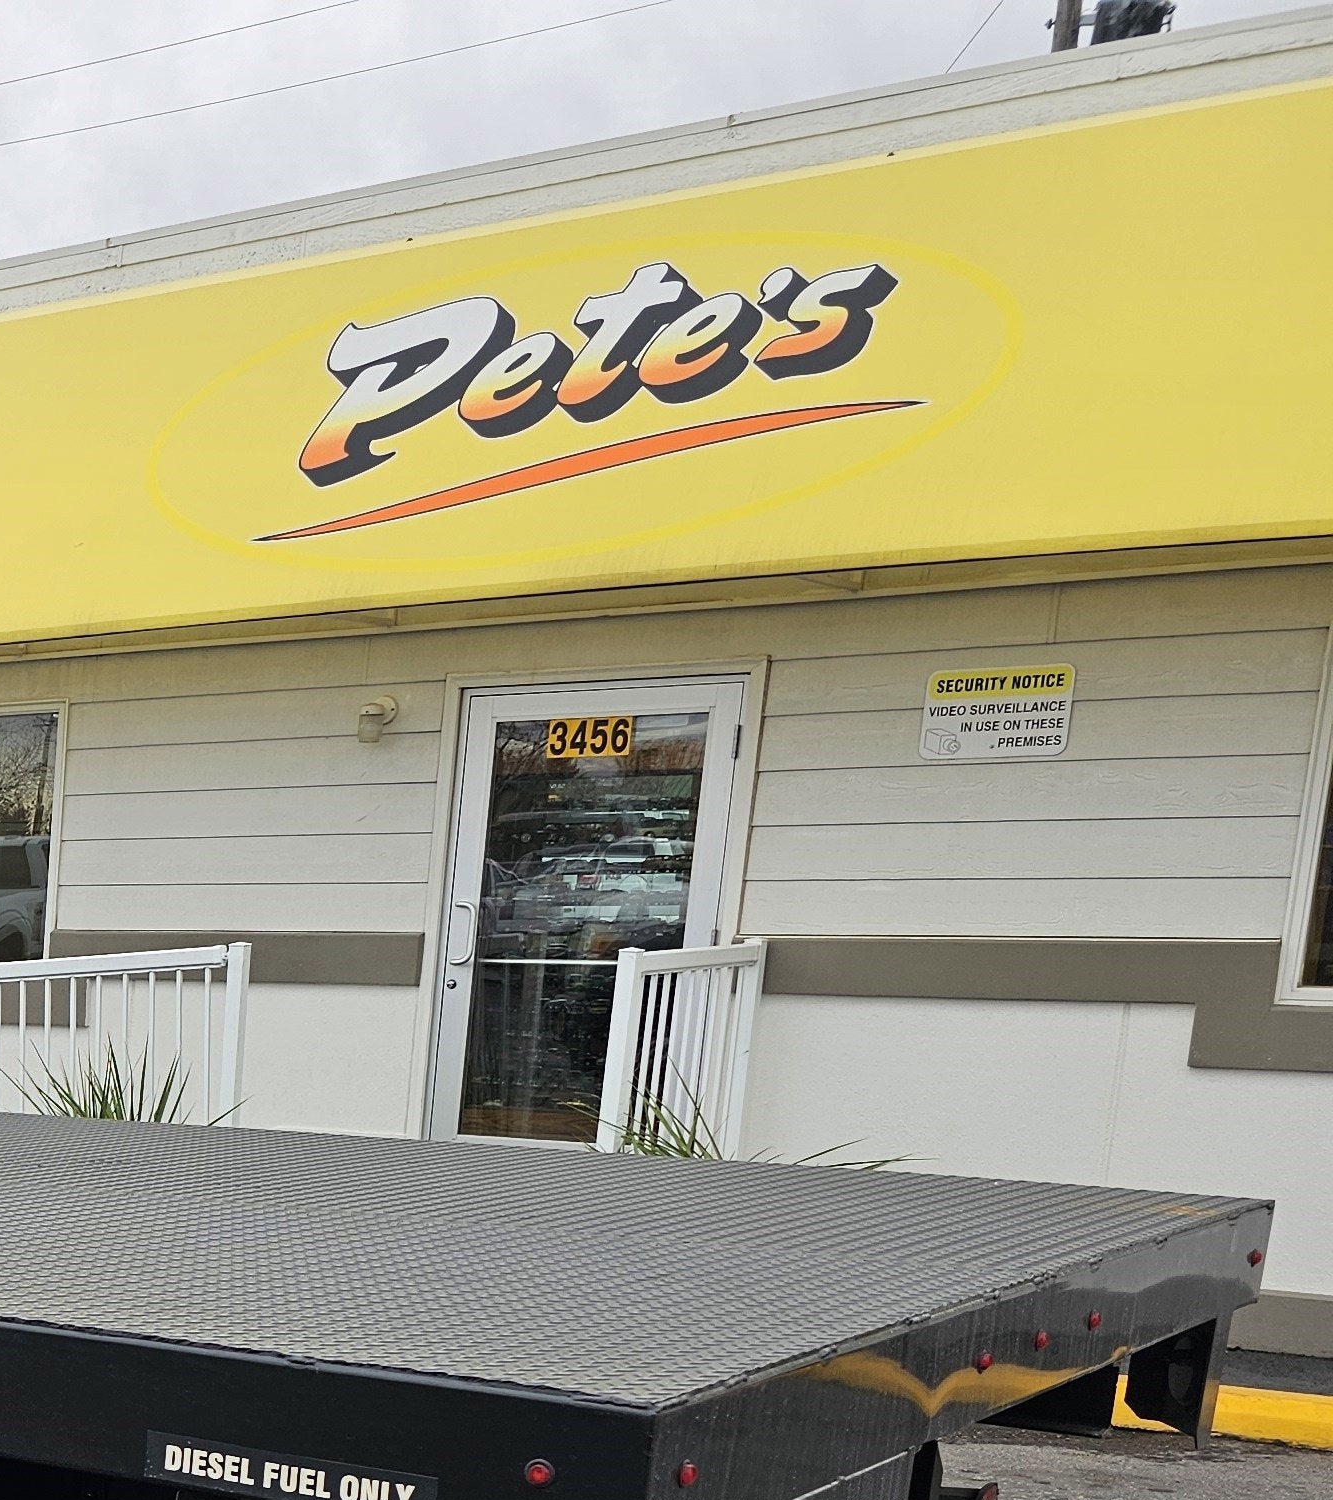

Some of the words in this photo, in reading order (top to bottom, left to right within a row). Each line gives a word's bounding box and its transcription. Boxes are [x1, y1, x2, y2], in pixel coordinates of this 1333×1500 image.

[298, 262, 899, 487] Pete's
[936, 676, 1008, 694] SECURITY
[1011, 673, 1065, 690] NOTICE
[929, 705, 966, 717] VIDEO
[969, 700, 1066, 716] SURVEILLANCE
[960, 721, 973, 733] IN
[975, 720, 1000, 732] USE
[1003, 719, 1021, 731] ON
[1024, 717, 1065, 730] THESE
[549, 718, 630, 756] 3456
[997, 734, 1062, 748] PREMISES
[164, 1444, 255, 1486] DIESEL
[263, 1461, 331, 1499] FUEL
